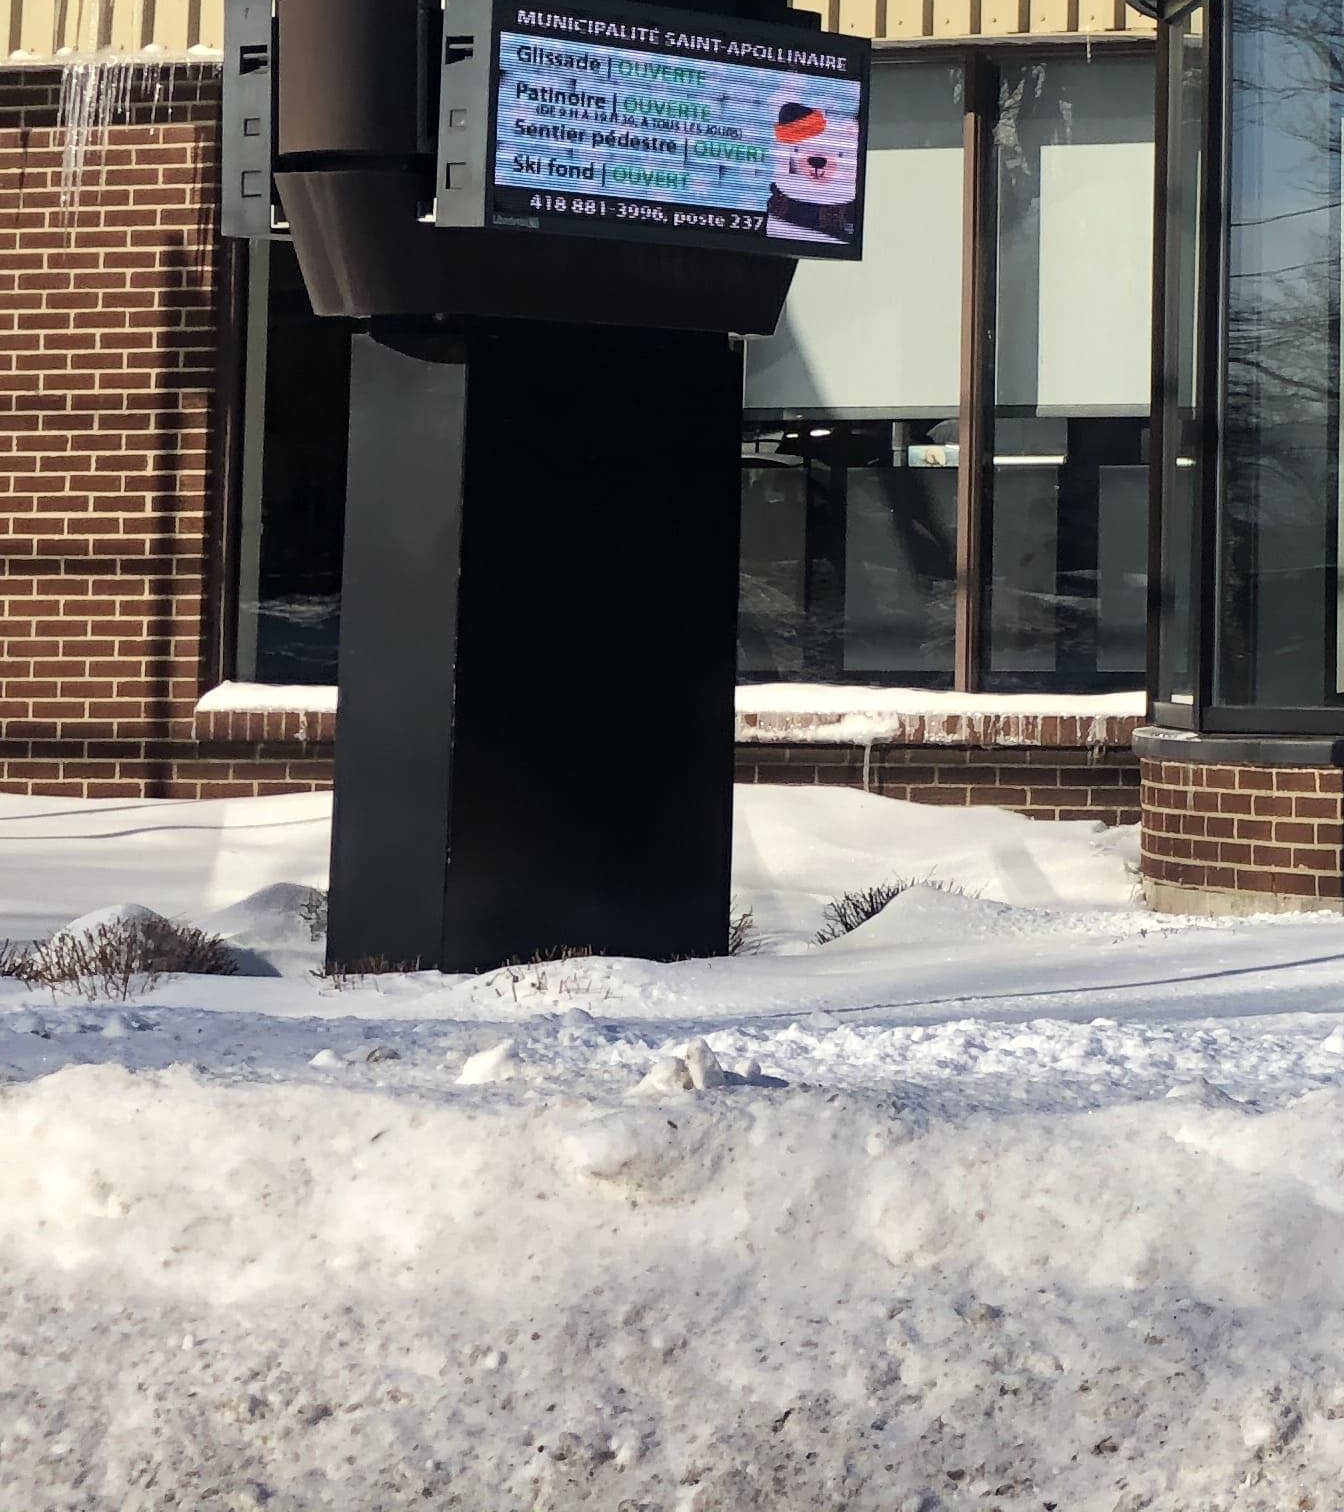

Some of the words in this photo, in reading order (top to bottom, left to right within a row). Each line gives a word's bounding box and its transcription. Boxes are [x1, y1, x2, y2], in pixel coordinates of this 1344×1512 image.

[516, 9, 660, 45] MUNICIPALITÉ
[664, 31, 848, 72] SAINT-APOLLINAIRE
[516, 45, 601, 71] Glissade
[618, 59, 706, 86] OUVERTE
[516, 81, 606, 110] Patinoire
[623, 94, 711, 122] OUVERTE
[514, 118, 585, 143] Sentier
[592, 129, 678, 153] pédestre
[694, 140, 770, 163] OUVERT
[512, 154, 542, 175] Ski
[548, 157, 595, 180] fond
[612, 165, 690, 188] OUVERT
[529, 193, 567, 213] 418
[673, 210, 726, 228] poste
[728, 214, 764, 232] 237
